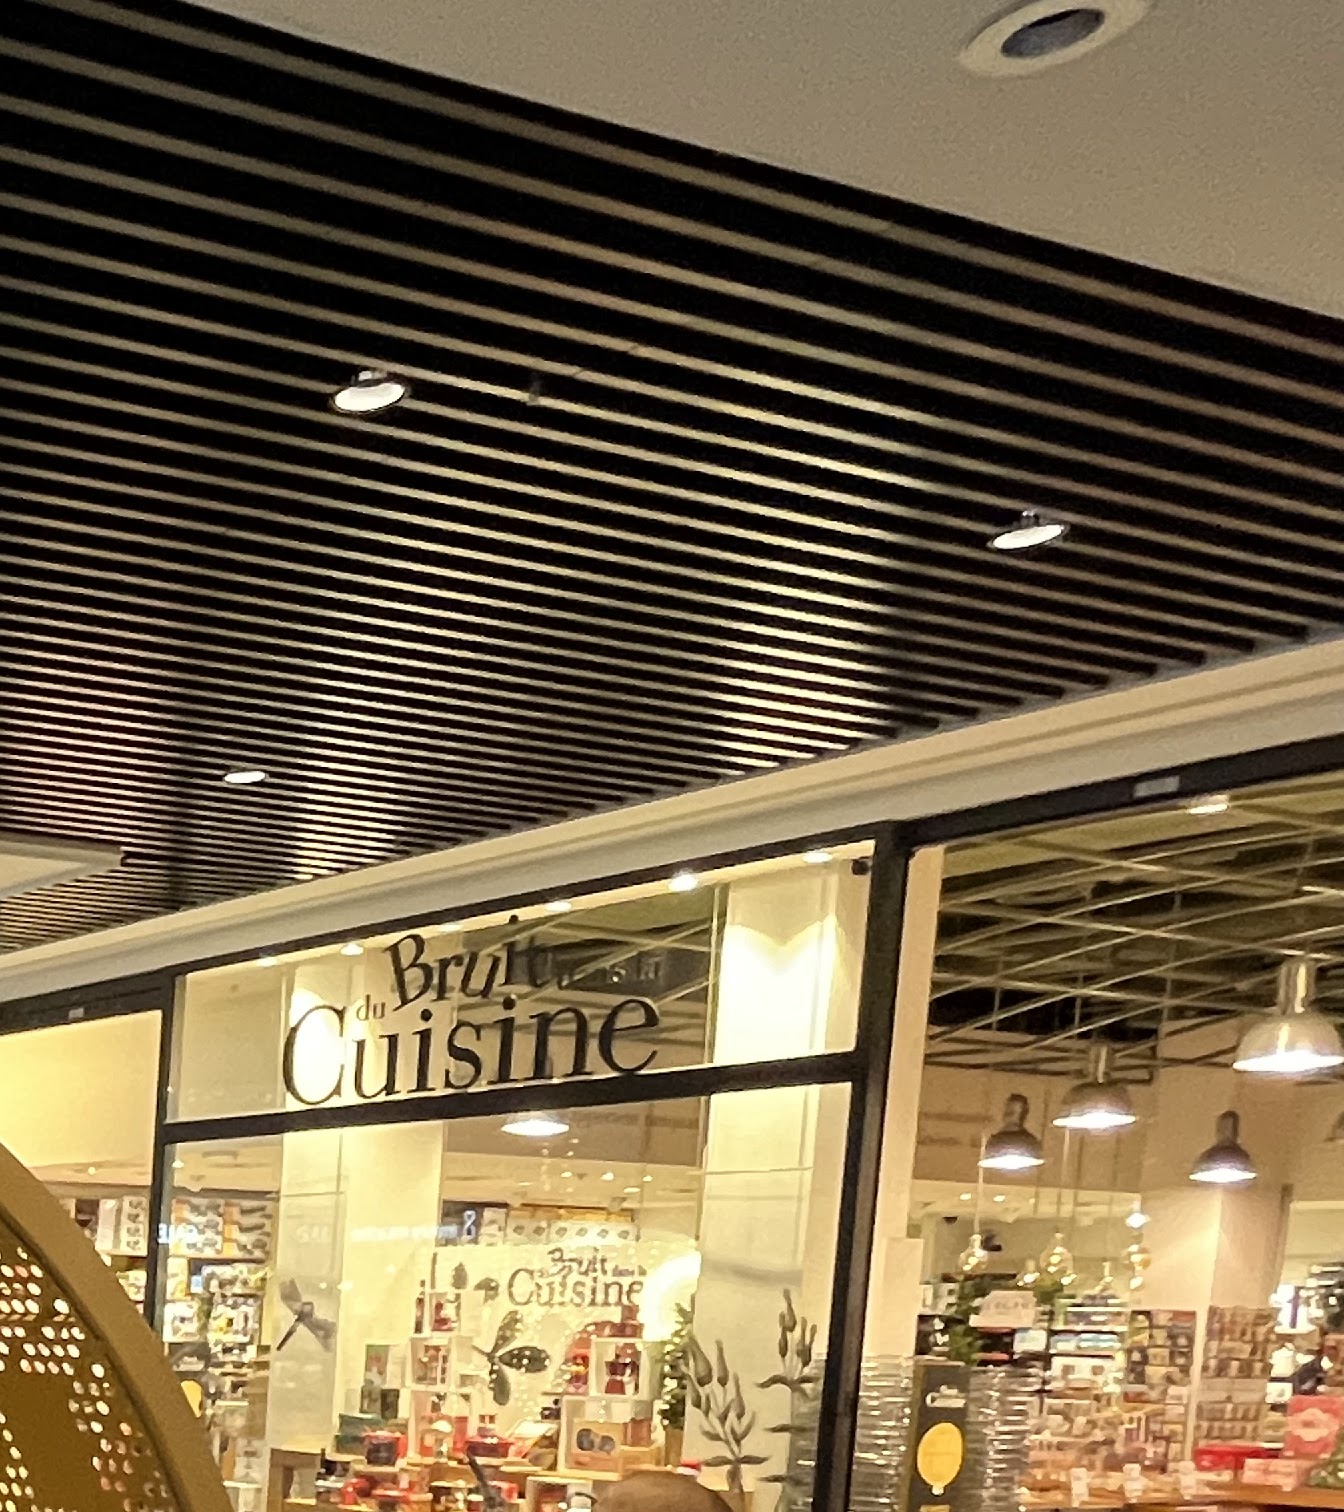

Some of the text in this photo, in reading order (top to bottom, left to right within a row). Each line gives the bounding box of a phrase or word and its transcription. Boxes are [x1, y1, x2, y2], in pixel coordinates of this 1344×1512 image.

[383, 914, 554, 1011] Bruit
[357, 995, 386, 1021] du
[282, 995, 660, 1105] Cuisine
[508, 1268, 643, 1307] Cuisine
